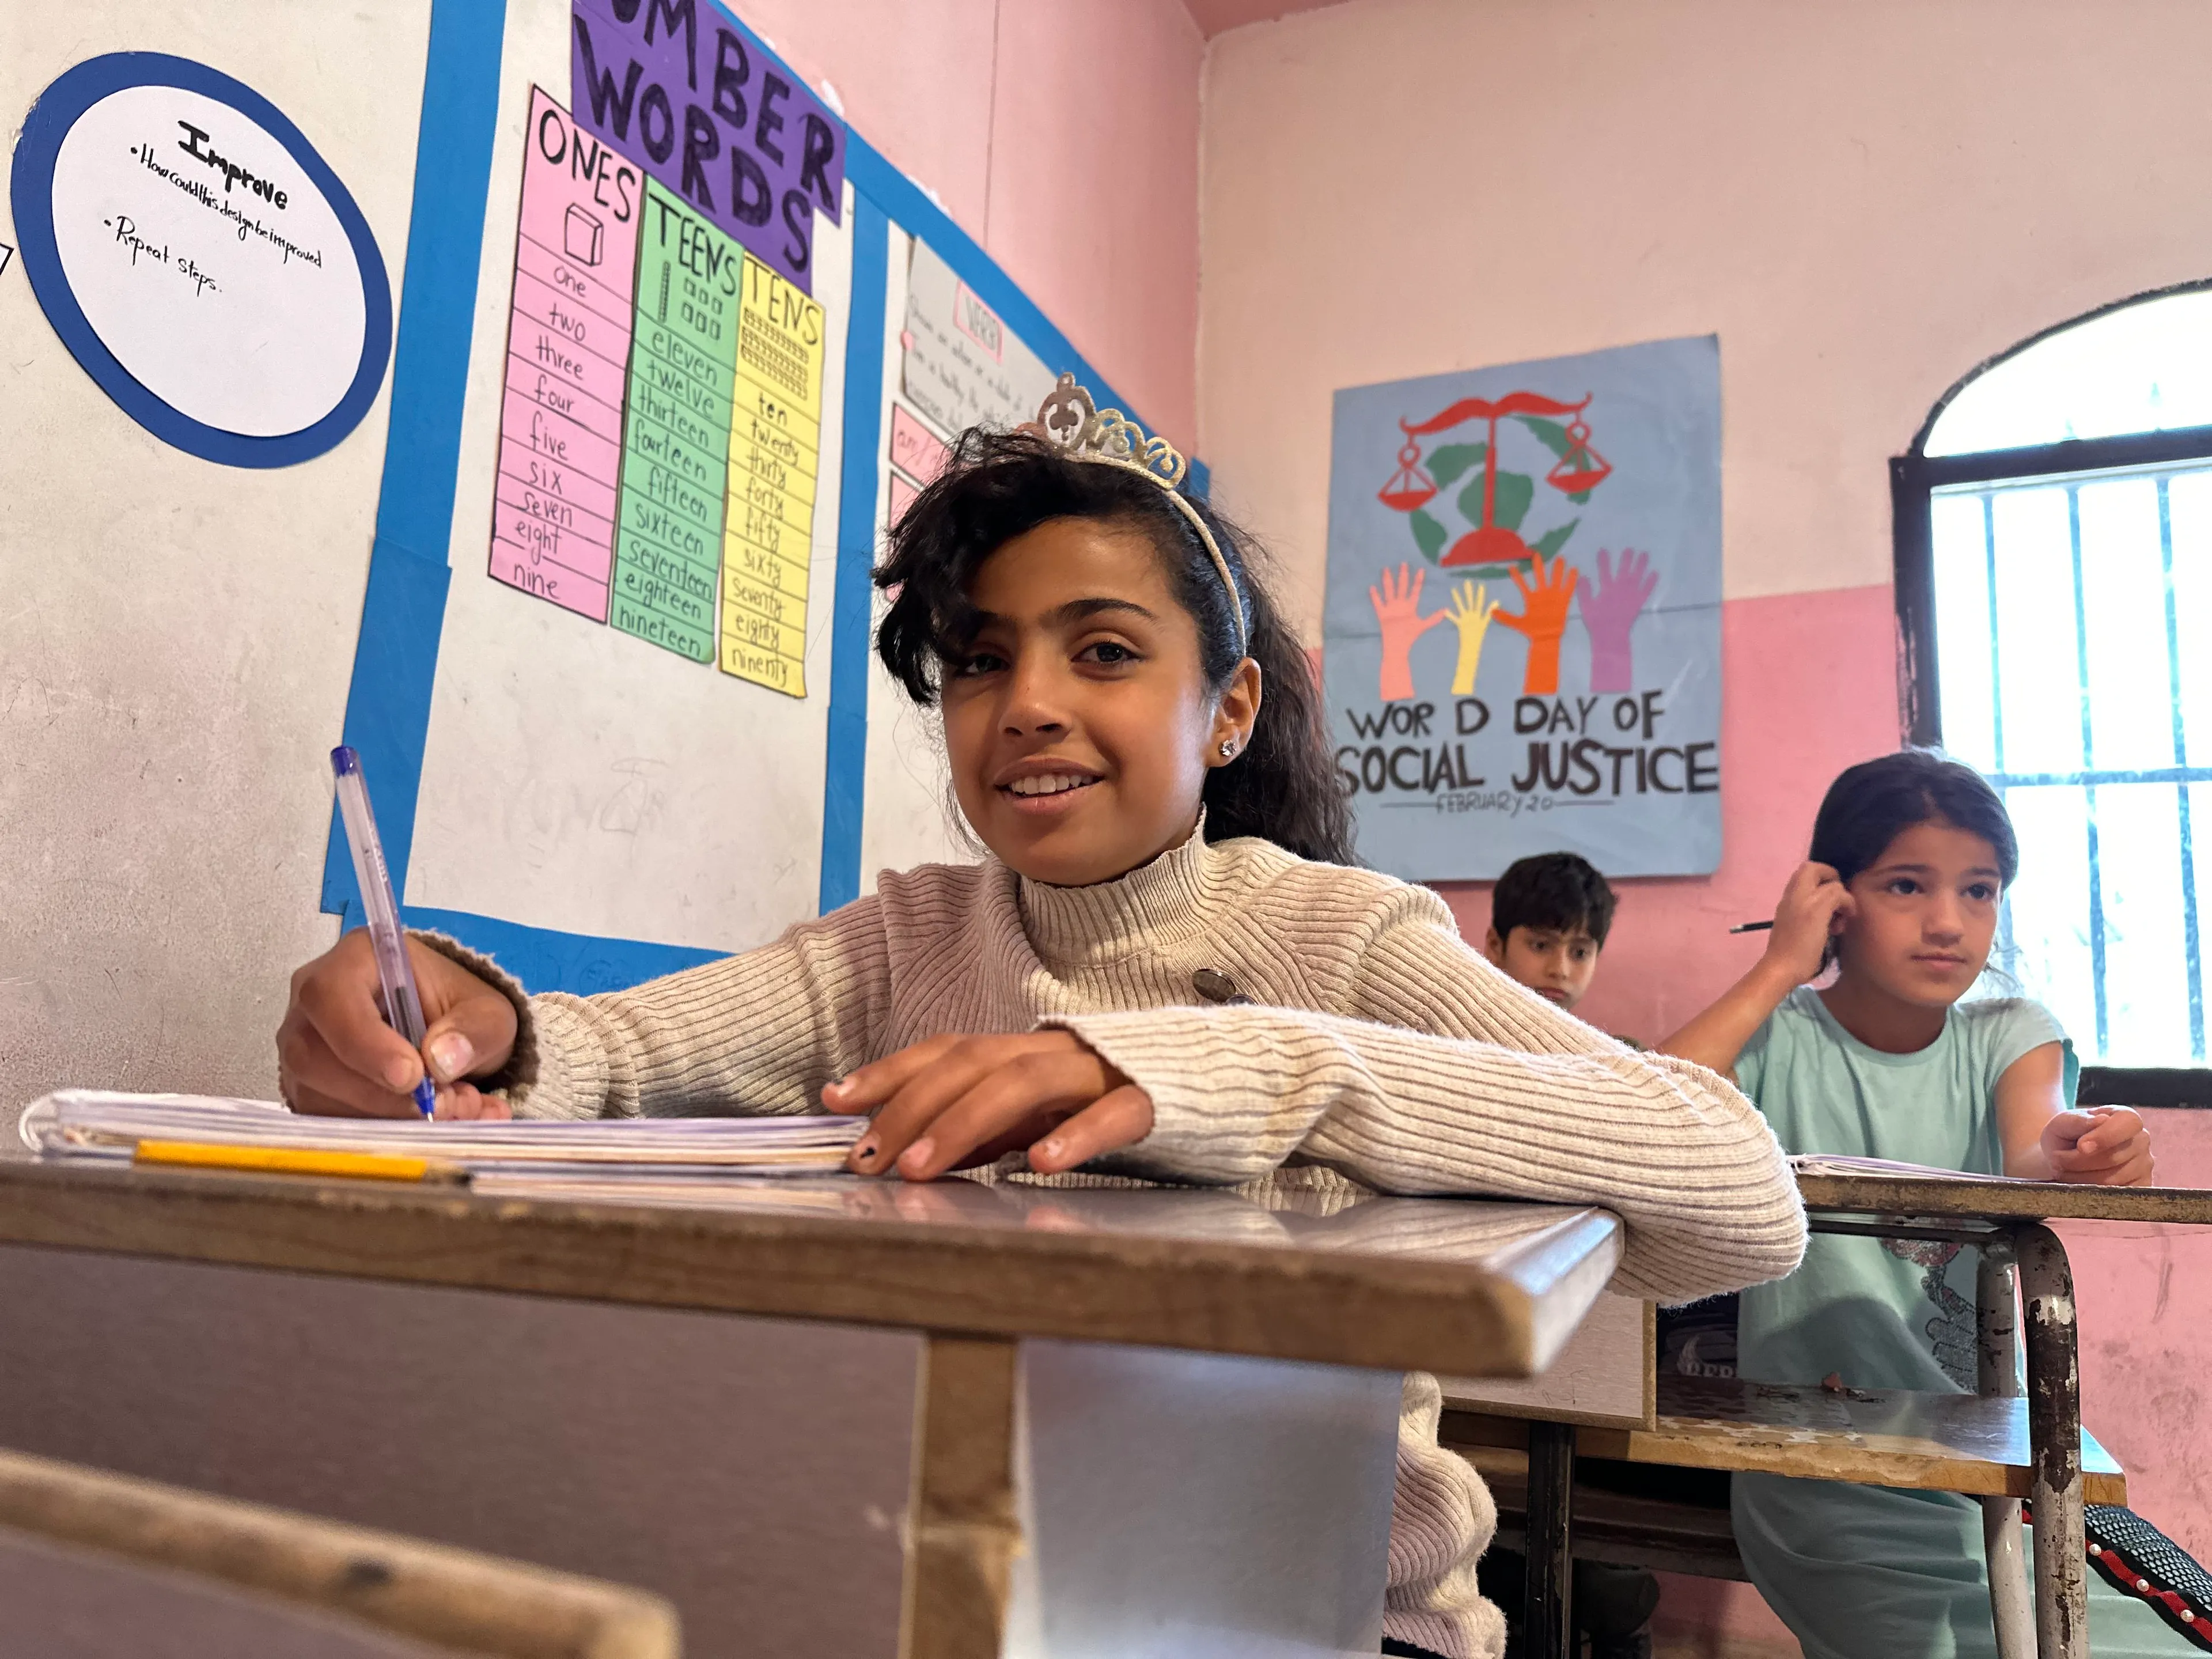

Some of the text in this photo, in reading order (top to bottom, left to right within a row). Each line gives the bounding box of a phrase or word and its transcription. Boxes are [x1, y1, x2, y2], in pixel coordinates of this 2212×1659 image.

[177, 120, 287, 210] Improve
[539, 110, 635, 222] ONES
[573, 14, 811, 272] WORDS
[141, 143, 169, 177] How
[199, 184, 218, 210] this
[220, 200, 253, 241] design
[255, 220, 268, 238] be
[270, 228, 321, 268] improved
[116, 215, 169, 266] Repeat
[649, 193, 736, 296] TEENS
[553, 266, 586, 297] one
[744, 256, 820, 345] TENS
[549, 303, 586, 342] two
[536, 335, 583, 380] three
[652, 331, 717, 387] eleven
[534, 374, 574, 413] four
[647, 359, 714, 419] twelve
[759, 392, 787, 426] ten
[530, 410, 568, 460] five
[639, 384, 709, 448] thirteen
[634, 418, 706, 482] fourteen
[751, 418, 798, 467] twenty
[530, 461, 562, 495] six
[746, 446, 786, 490] thirty
[648, 466, 707, 522] fifteen
[745, 476, 783, 521] forty
[515, 521, 562, 565] eight
[745, 506, 779, 552] fifty
[514, 563, 560, 600] nine
[744, 548, 781, 590] sixty
[625, 574, 701, 619] eighteen
[619, 606, 700, 657] nineteen
[736, 614, 779, 652] eighty
[1514, 696, 1598, 734] DAY
[1613, 689, 1665, 739] OF
[1335, 739, 1719, 796] SOCIAL JUSTICE
[1437, 790, 1555, 819] FEBRUARY 20
